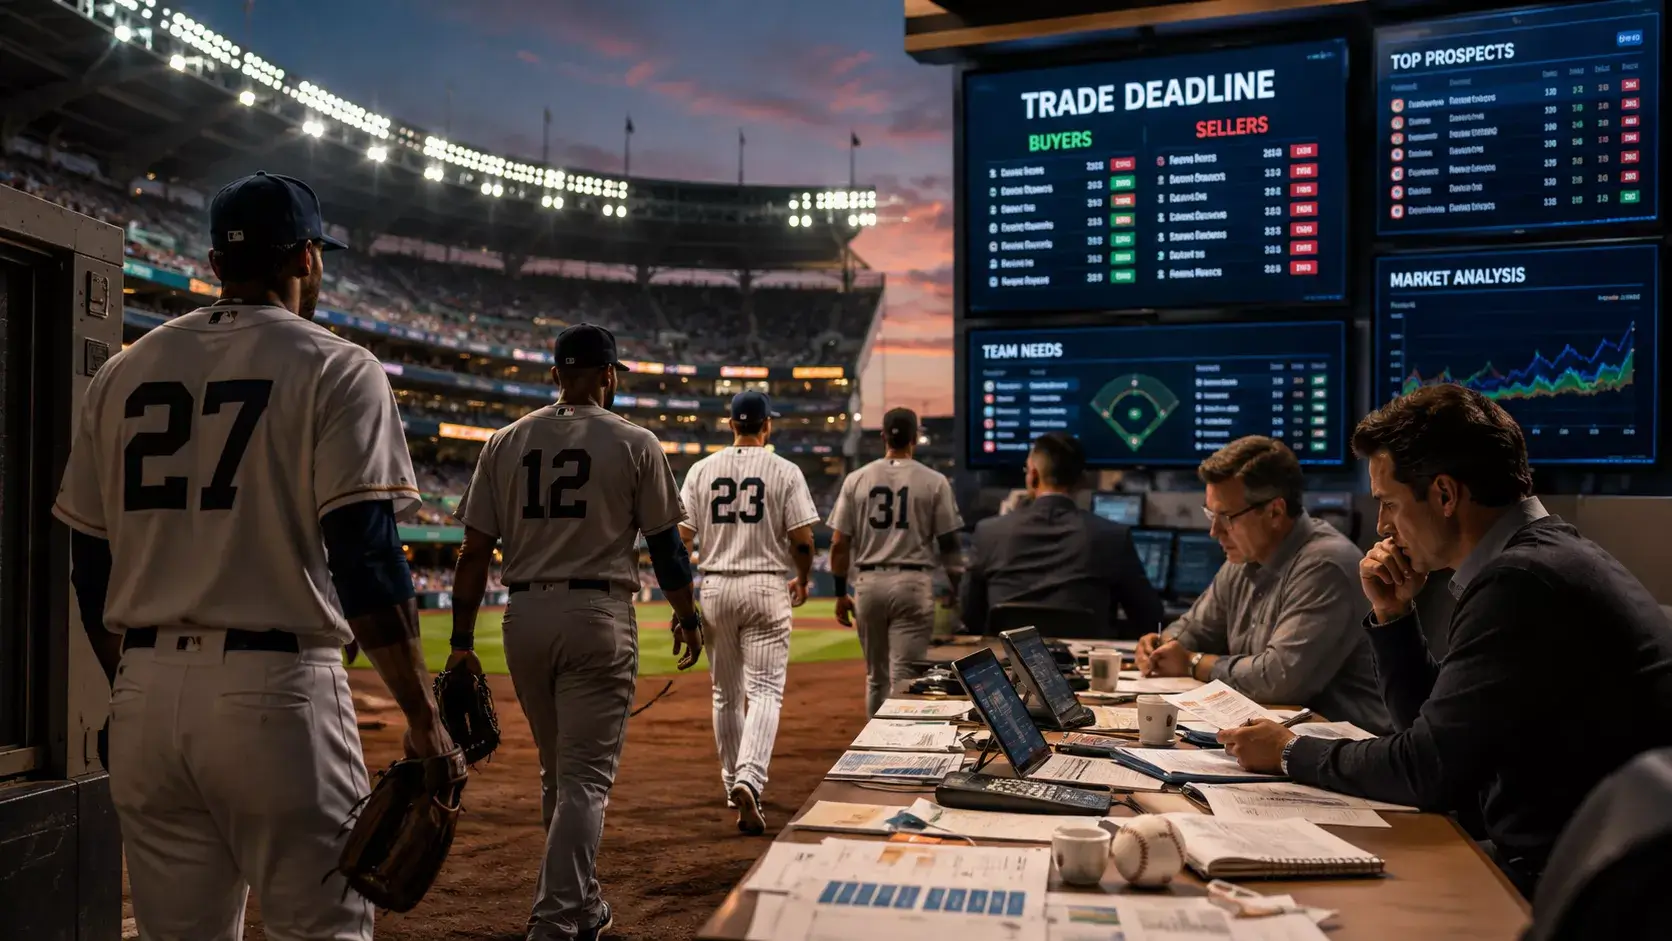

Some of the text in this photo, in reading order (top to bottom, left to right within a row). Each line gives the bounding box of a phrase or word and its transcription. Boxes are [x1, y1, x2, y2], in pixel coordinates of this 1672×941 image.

[1390, 42, 1515, 70] TOP PROSPECTS
[1020, 69, 1276, 119] TRADE DEADLINE
[1028, 130, 1093, 152] BUYERS
[1195, 115, 1269, 138] SELLERS
[1390, 266, 1526, 288] MARKET ANALYSIS
[982, 342, 1063, 359] TEAM NEEDS
[124, 379, 274, 511] 27
[522, 448, 592, 519] 12
[711, 477, 765, 524] 23
[868, 486, 910, 530] 31
